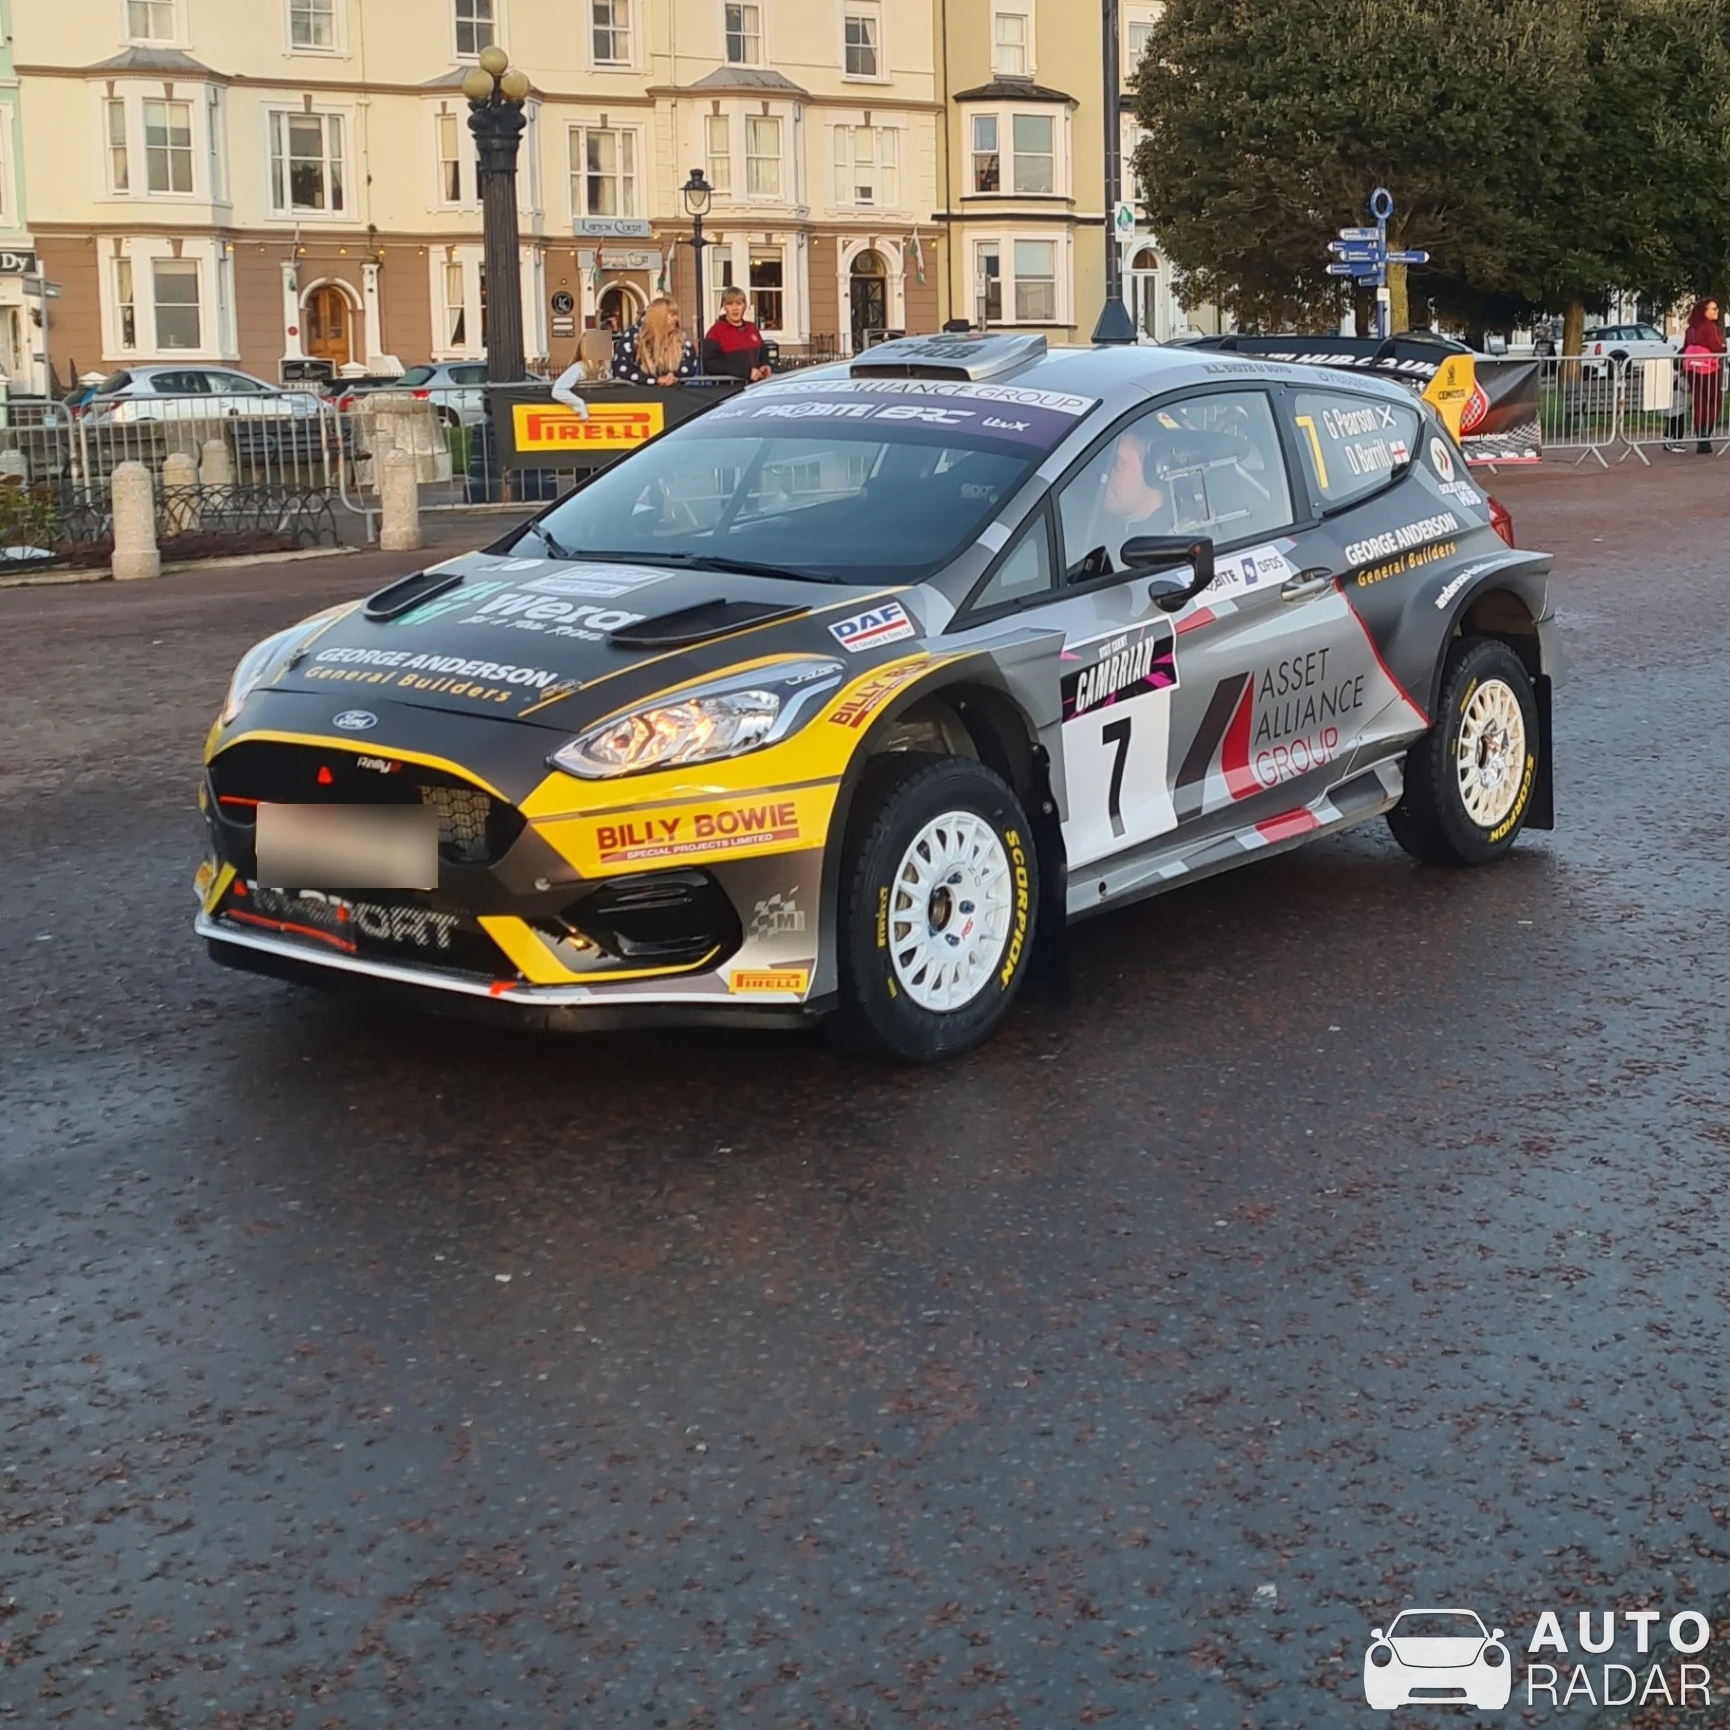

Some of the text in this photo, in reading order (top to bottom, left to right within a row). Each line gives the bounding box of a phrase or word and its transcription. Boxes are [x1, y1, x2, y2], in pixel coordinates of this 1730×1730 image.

[852, 381, 972, 397] ALLIANCE
[974, 386, 1085, 409] GROUP
[526, 412, 650, 441] PIRELLI
[1323, 407, 1379, 440] G Pearson
[1344, 512, 1459, 566] GEORGE ANDERSON
[1257, 556, 1284, 573] DFDS
[1357, 541, 1457, 588] General Builders
[476, 593, 647, 632] Wera
[833, 604, 902, 638] DAF
[304, 665, 513, 703] General Builders
[315, 647, 559, 689] GEORGE ANDERSON
[1075, 635, 1155, 713] CAMBRIAN
[1258, 648, 1330, 704] ASSET
[827, 680, 885, 726] BILLY
[1253, 674, 1365, 746] ALLIANCE
[1102, 717, 1132, 838] 7
[1254, 726, 1339, 787] GROUP
[1488, 753, 1535, 843] SCORPION
[596, 802, 798, 850] BILLY BOWIE
[626, 832, 774, 860] SPECIAL PROJECTS LIMITED
[1001, 830, 1029, 991] SCORPION
[736, 974, 801, 988] PIRELLI
